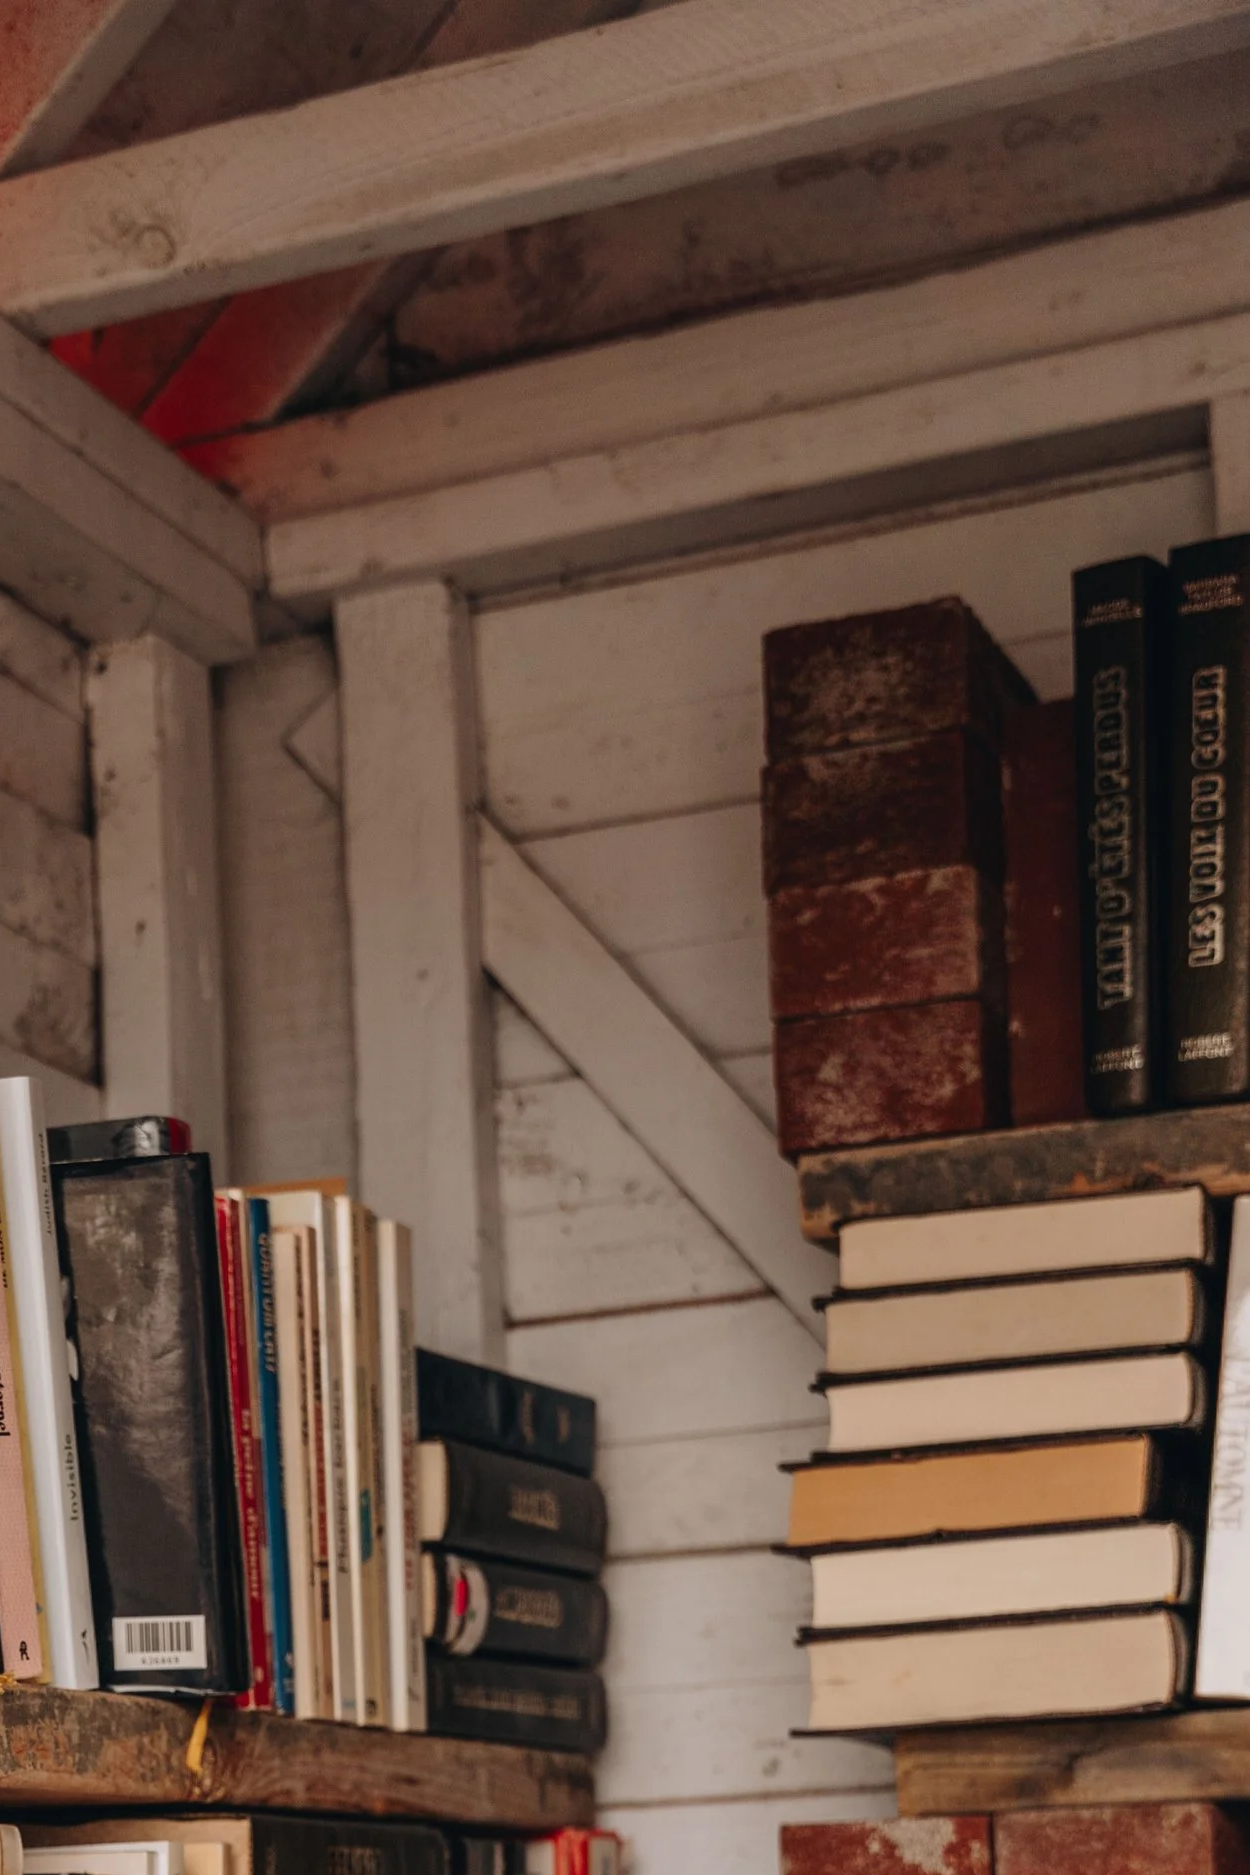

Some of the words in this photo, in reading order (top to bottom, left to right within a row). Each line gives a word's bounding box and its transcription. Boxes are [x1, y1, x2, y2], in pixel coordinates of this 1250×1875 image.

[1093, 664, 1129, 795] PERDUS
[1191, 775, 1225, 821] DU
[1188, 822, 1226, 901] VOIX
[1096, 922, 1135, 1008] TANT
[1188, 904, 1225, 968] LES
[64, 1433, 79, 1522] Invisible
